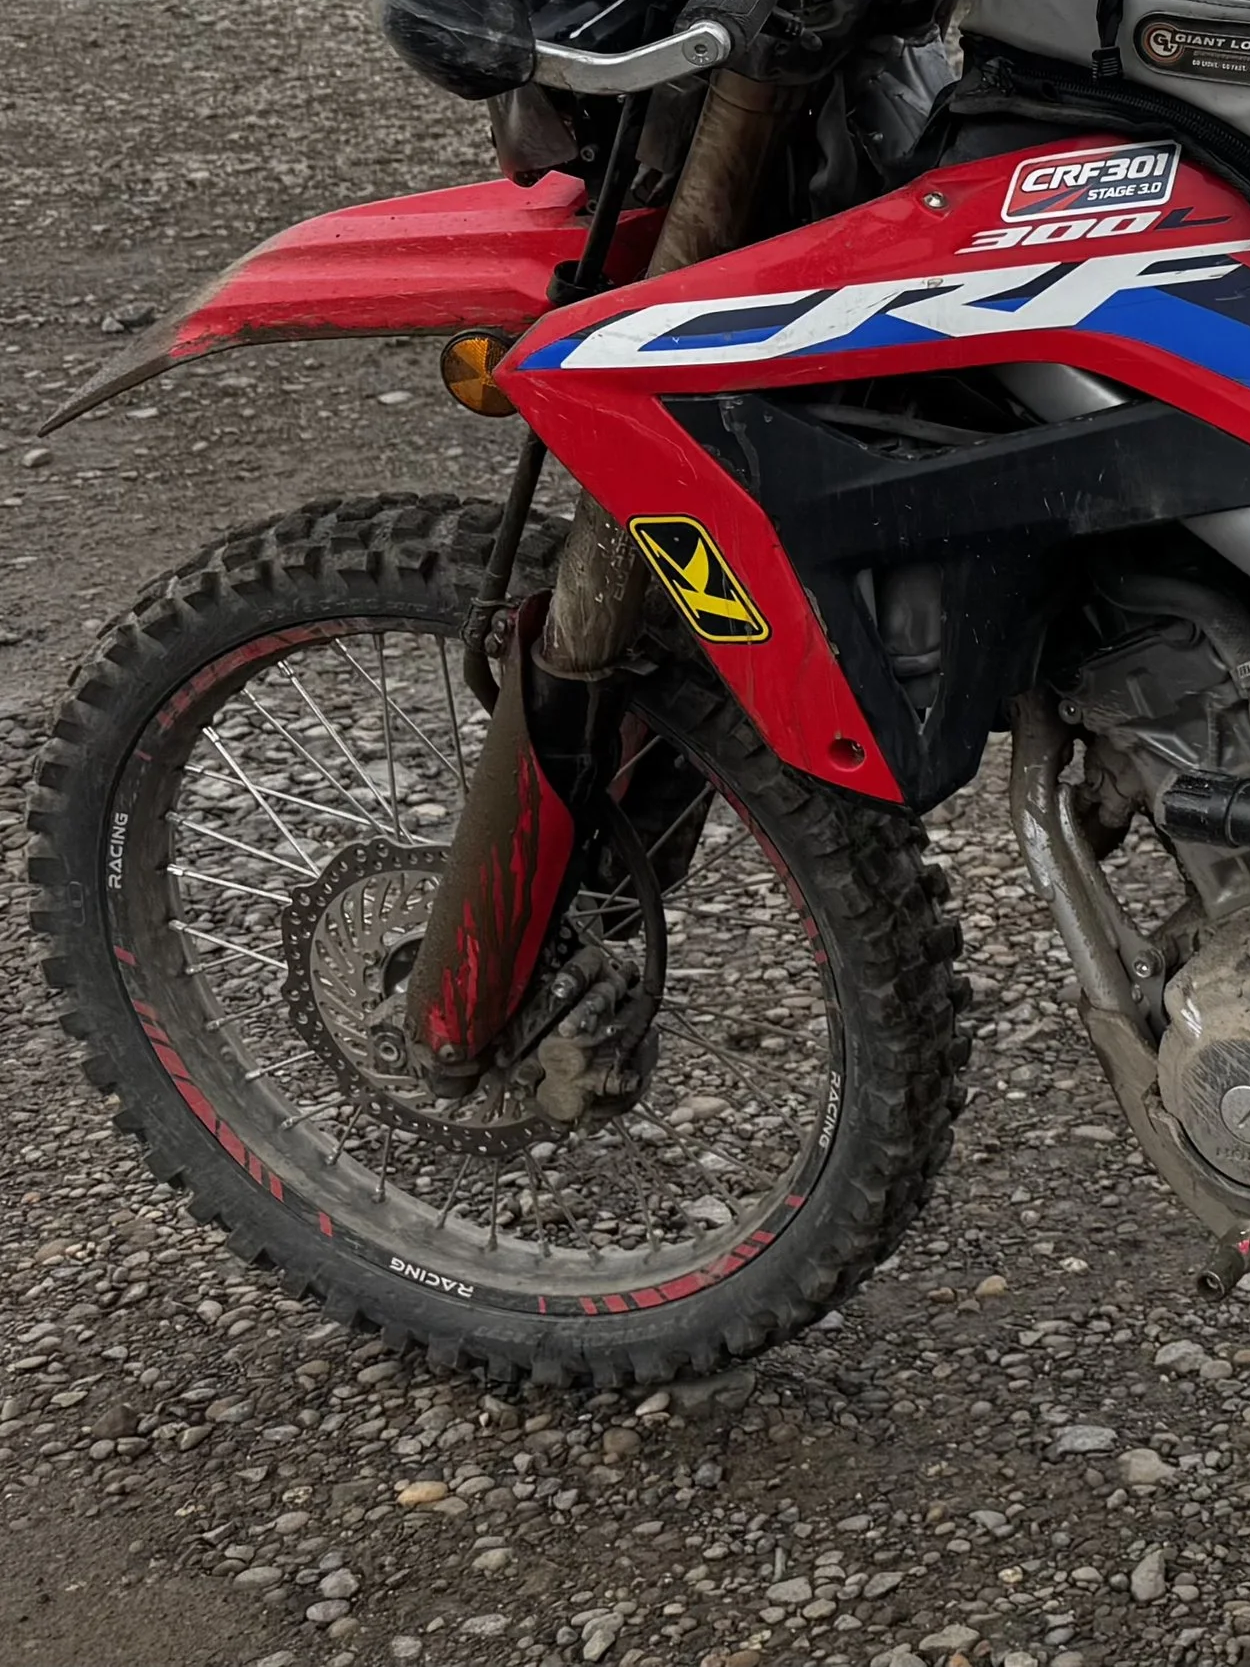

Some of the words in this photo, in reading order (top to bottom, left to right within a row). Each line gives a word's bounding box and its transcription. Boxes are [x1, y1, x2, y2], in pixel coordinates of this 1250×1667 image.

[1175, 33, 1226, 48] GIANT
[1021, 153, 1169, 193] CRF301
[1087, 185, 1136, 201] STAGE
[1137, 182, 1162, 196] 3.0
[954, 207, 1231, 254] 300L
[108, 813, 128, 889] RACING
[818, 1071, 840, 1148] RACING
[389, 1257, 474, 1299] RACING
